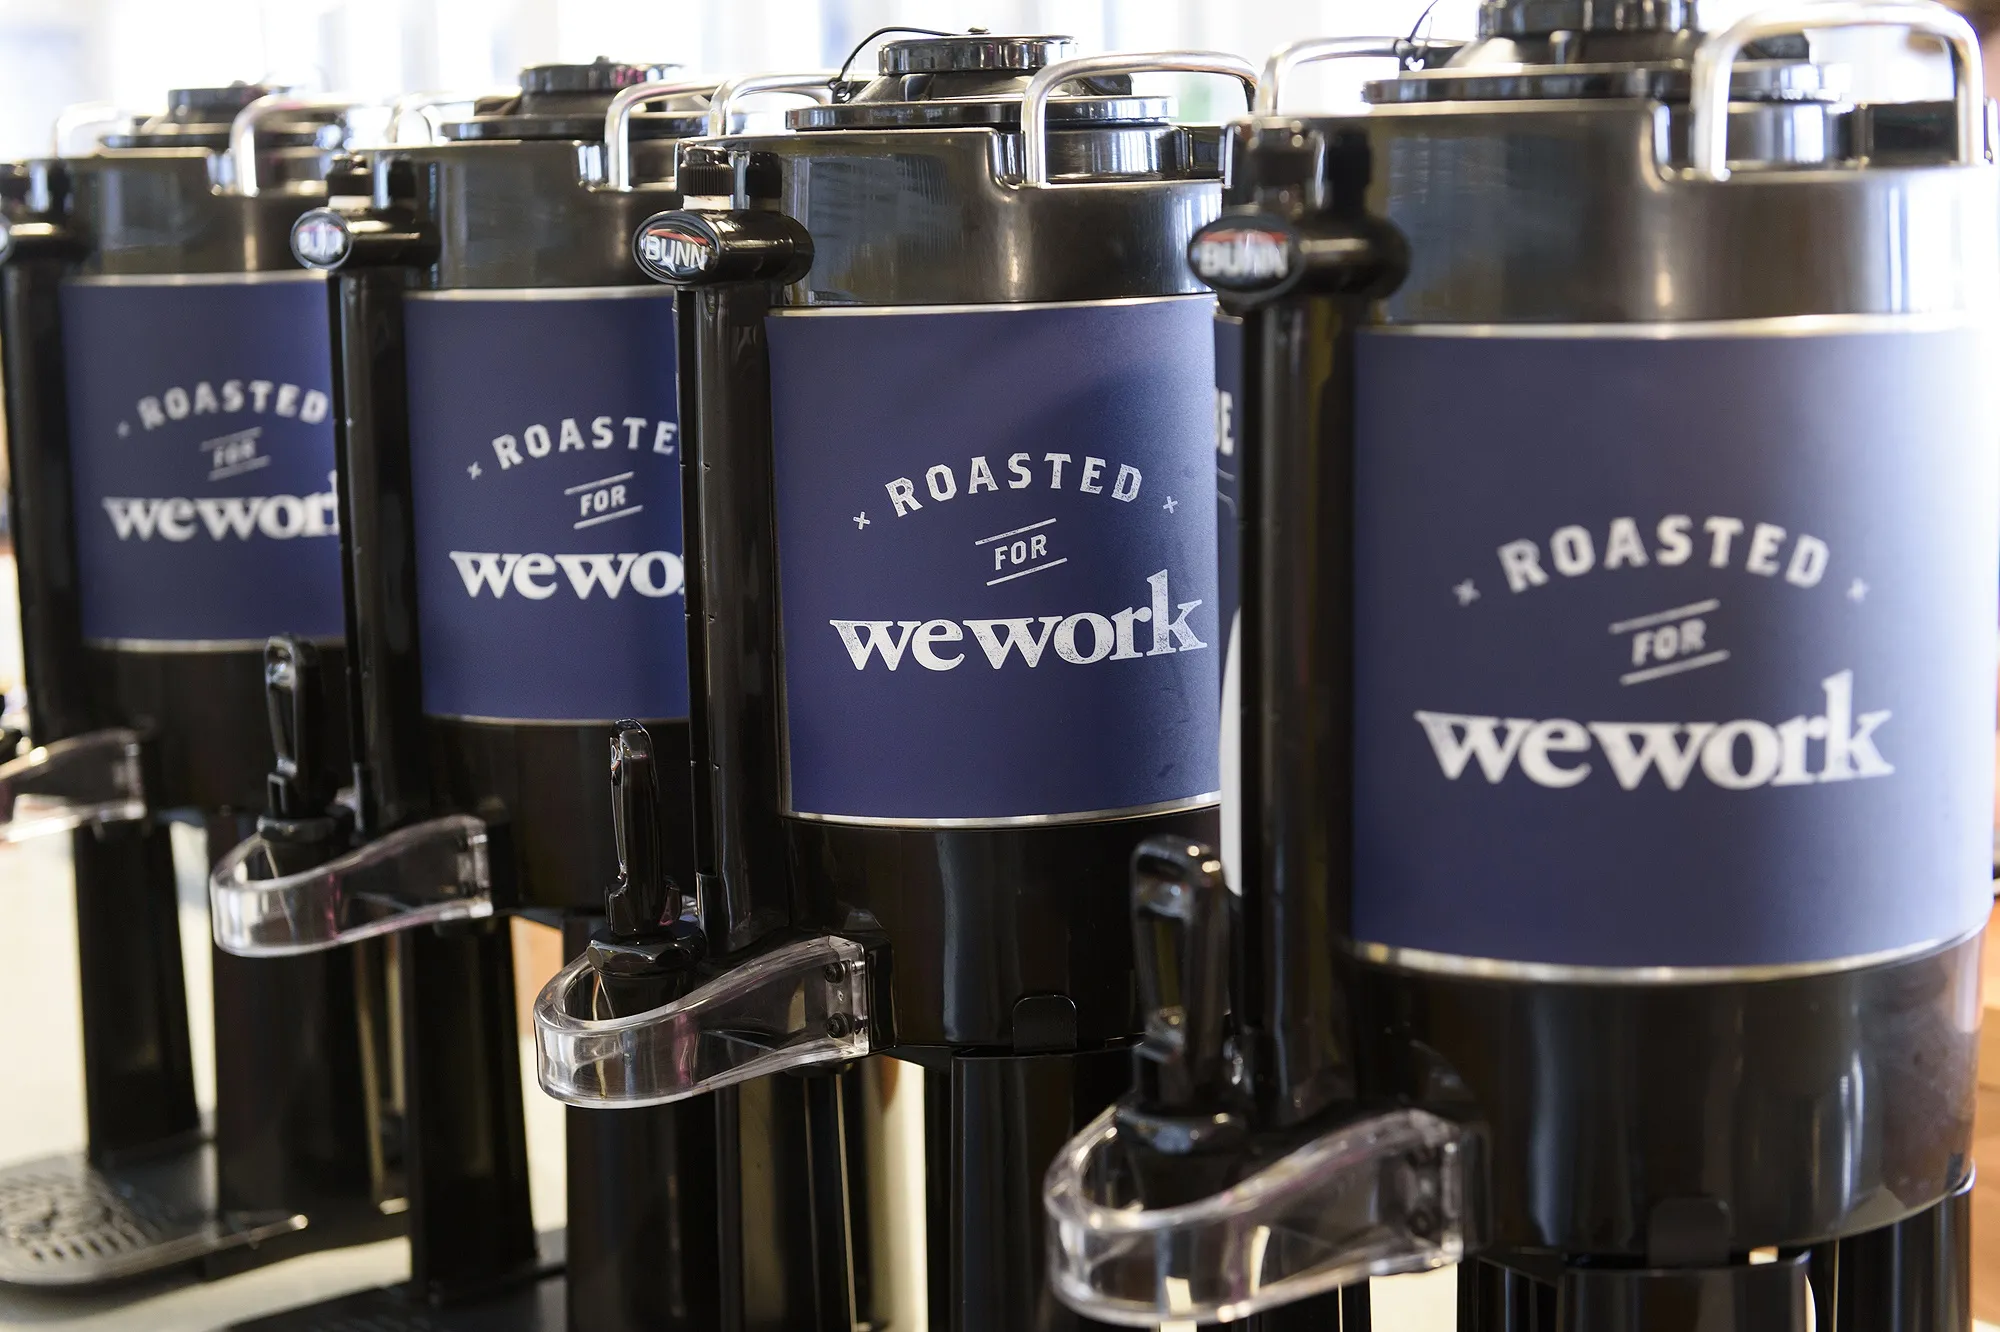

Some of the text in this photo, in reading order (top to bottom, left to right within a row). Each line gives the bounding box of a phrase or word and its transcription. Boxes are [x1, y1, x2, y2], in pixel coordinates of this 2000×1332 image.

[645, 235, 706, 271] BUNN
[137, 379, 329, 431] ROASTED
[102, 469, 340, 543] wewor
[580, 485, 626, 517] FOR
[885, 452, 1142, 517] ROASTED
[449, 550, 685, 600] wewo
[994, 534, 1047, 571] FOR
[1498, 514, 1830, 593] ROASTED
[829, 569, 1208, 671] wework
[1631, 618, 1706, 666] FOR
[1414, 669, 1895, 791] wework
